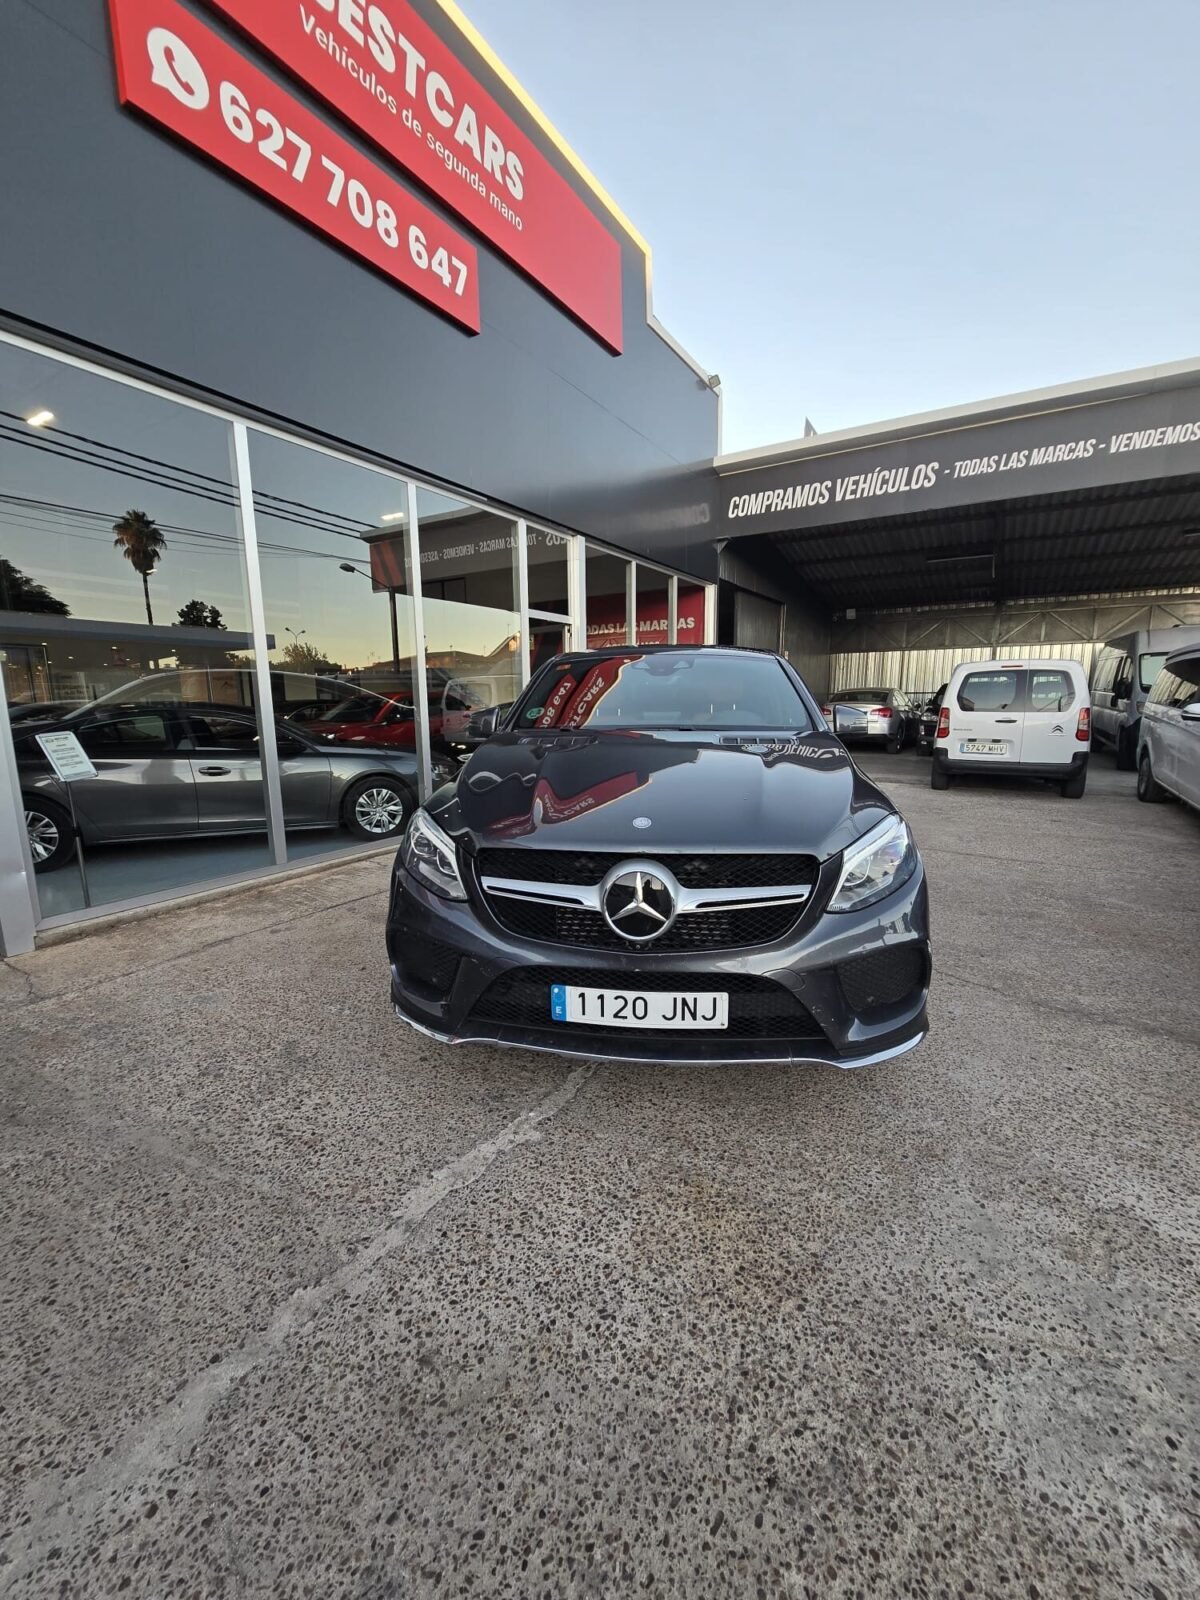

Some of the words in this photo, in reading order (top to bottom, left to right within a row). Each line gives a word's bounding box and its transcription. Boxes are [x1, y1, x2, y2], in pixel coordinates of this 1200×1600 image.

[300, 3, 397, 114] Vehículos
[402, 108, 422, 137] de
[426, 132, 486, 198] segunda
[490, 191, 522, 231] mano
[315, 0, 524, 200] ESTCARS
[219, 80, 312, 183] 627
[321, 155, 399, 248] 708
[408, 225, 468, 297] 647
[728, 480, 832, 519] COMPRAMOS
[835, 461, 940, 502] VEHÍCULOS
[953, 455, 999, 479] TODAS
[999, 449, 1028, 472] LAS
[1029, 438, 1096, 467] MARCAS
[1109, 421, 1200, 454] VENDEMOS
[640, 617, 695, 632] MARAS
[965, 744, 986, 752] 5747
[578, 992, 648, 1020] 1120
[661, 997, 717, 1022] JNJ
